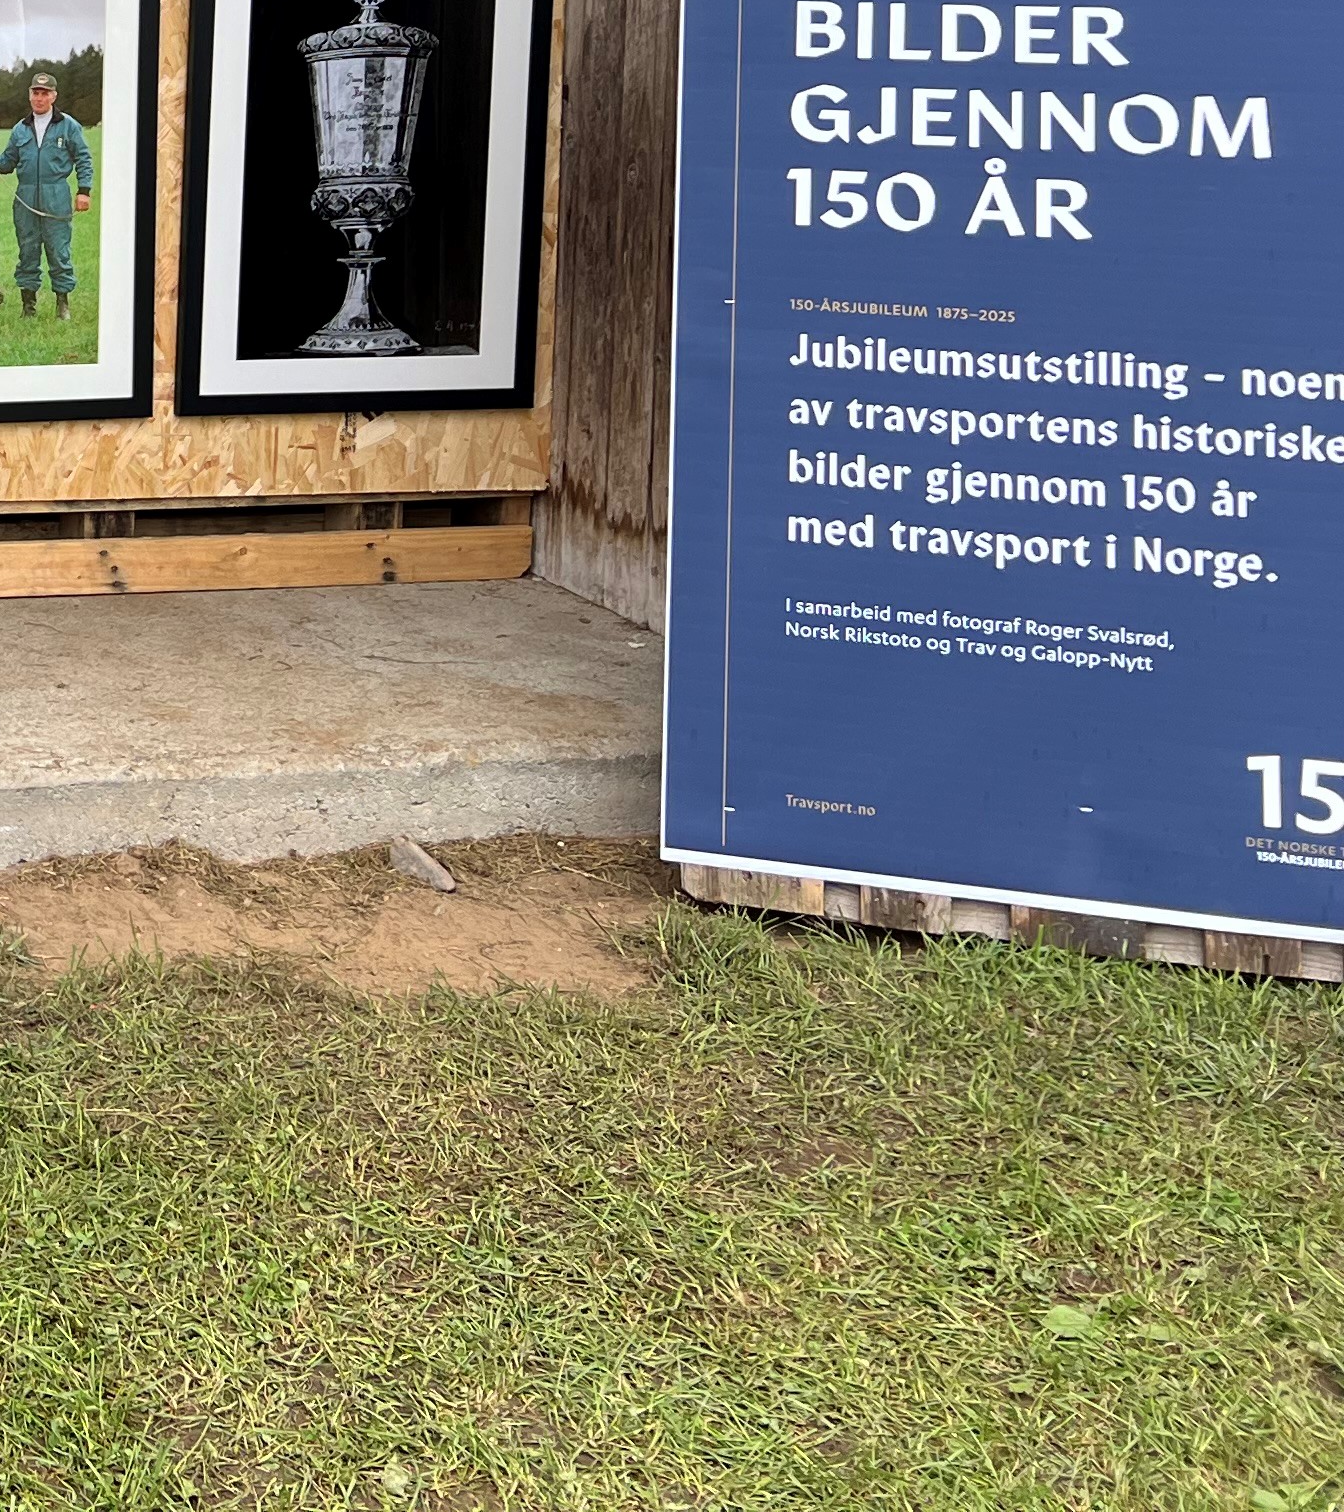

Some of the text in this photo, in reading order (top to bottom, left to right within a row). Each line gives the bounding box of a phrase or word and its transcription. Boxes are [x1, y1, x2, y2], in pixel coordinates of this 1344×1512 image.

[795, 0, 1130, 66] BILDER
[790, 84, 1273, 159] GJENNOM
[786, 157, 1093, 240] 150 ÅR
[789, 297, 928, 318] 150-ÅRSJUBILEUM
[789, 333, 1189, 400] Jubileumsutstilling
[1242, 365, 1344, 402] noen
[789, 397, 1344, 464] av travsportens historiske
[788, 449, 1258, 518] bilder gjennom 150 år
[787, 513, 1279, 589] med travsport i Norge.
[785, 598, 1175, 652] I samarbeid med fotograf Roger Svalsrød,
[785, 622, 1153, 674] Norsk Rikstoto og Trav og Galopp-Nytt
[785, 794, 876, 816] Travsport.no
[1246, 836, 1274, 848] DET
[1278, 840, 1336, 856] NORSKE
